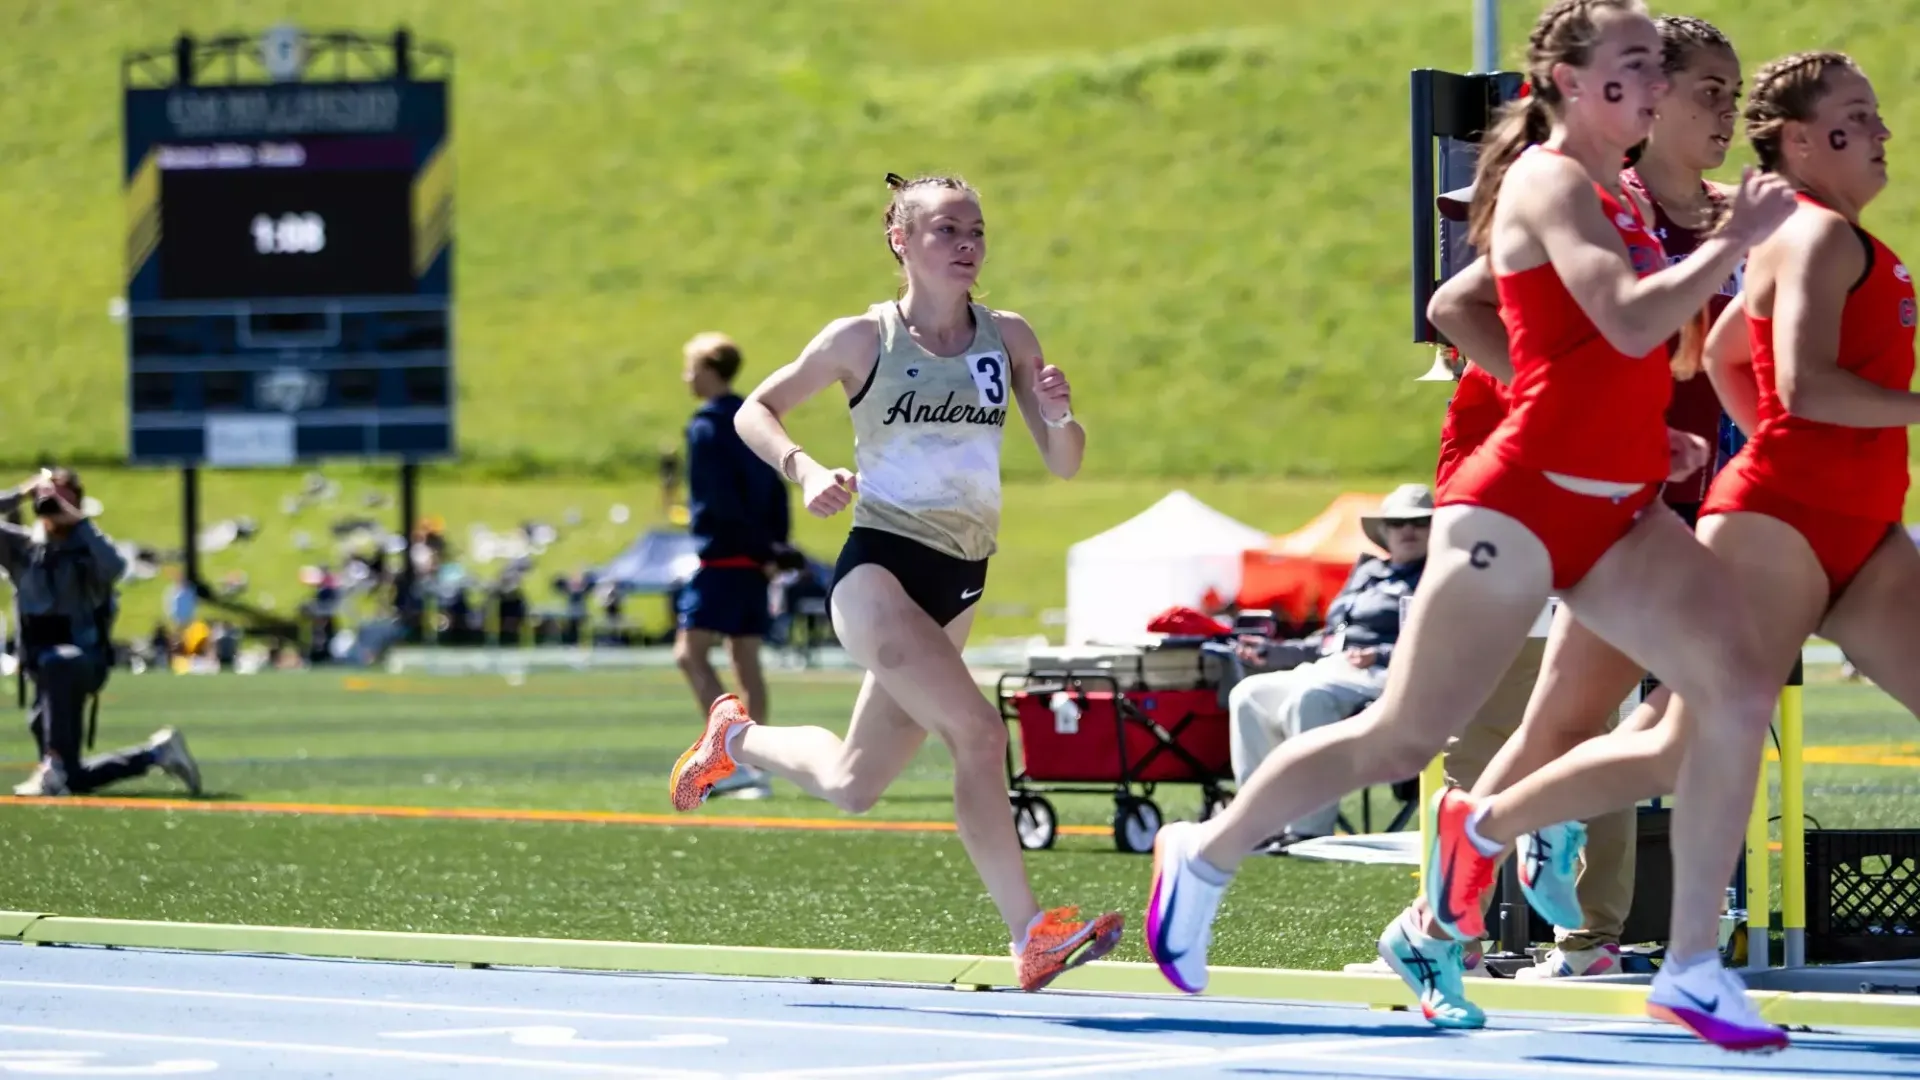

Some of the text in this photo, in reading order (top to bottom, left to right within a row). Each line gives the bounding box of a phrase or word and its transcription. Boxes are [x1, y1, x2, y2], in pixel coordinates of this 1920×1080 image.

[1603, 81, 1623, 103] C
[1829, 129, 1847, 151] C
[977, 357, 1004, 404] 3
[1470, 541, 1497, 569] C
